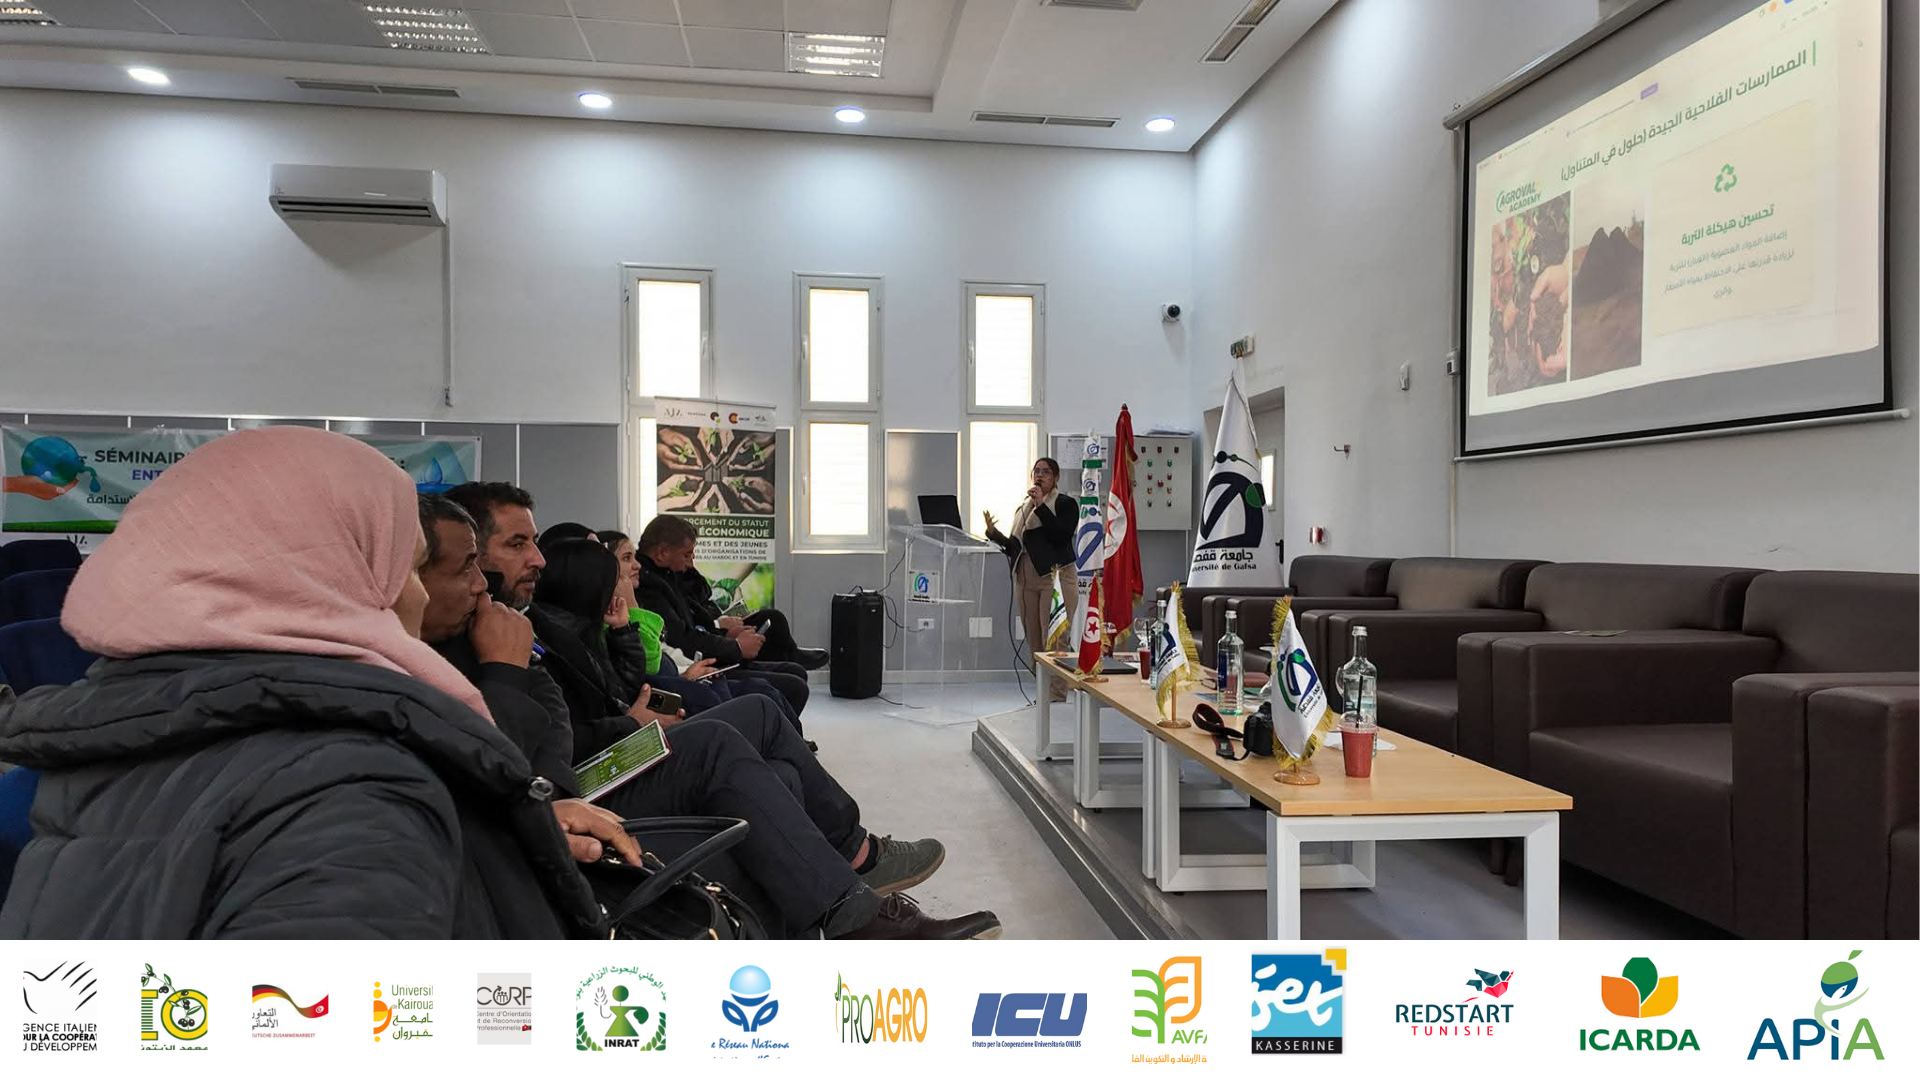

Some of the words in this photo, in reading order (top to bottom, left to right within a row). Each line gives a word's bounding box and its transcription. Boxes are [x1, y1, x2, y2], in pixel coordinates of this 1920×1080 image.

[1736, 49, 1806, 96] الممارسات
[1685, 86, 1732, 120] الفلاحية
[1648, 111, 1683, 139] الجيدة
[1601, 145, 1616, 165] في
[1509, 194, 1541, 213] ACADEMY
[1738, 203, 1775, 228] تحسين
[1681, 227, 1704, 246] التربة
[1706, 218, 1737, 236] هيكلة
[94, 447, 189, 464] SÉMINAIR
[699, 526, 769, 538] ÉCONOMIQUE
[1220, 549, 1254, 562] جامعة
